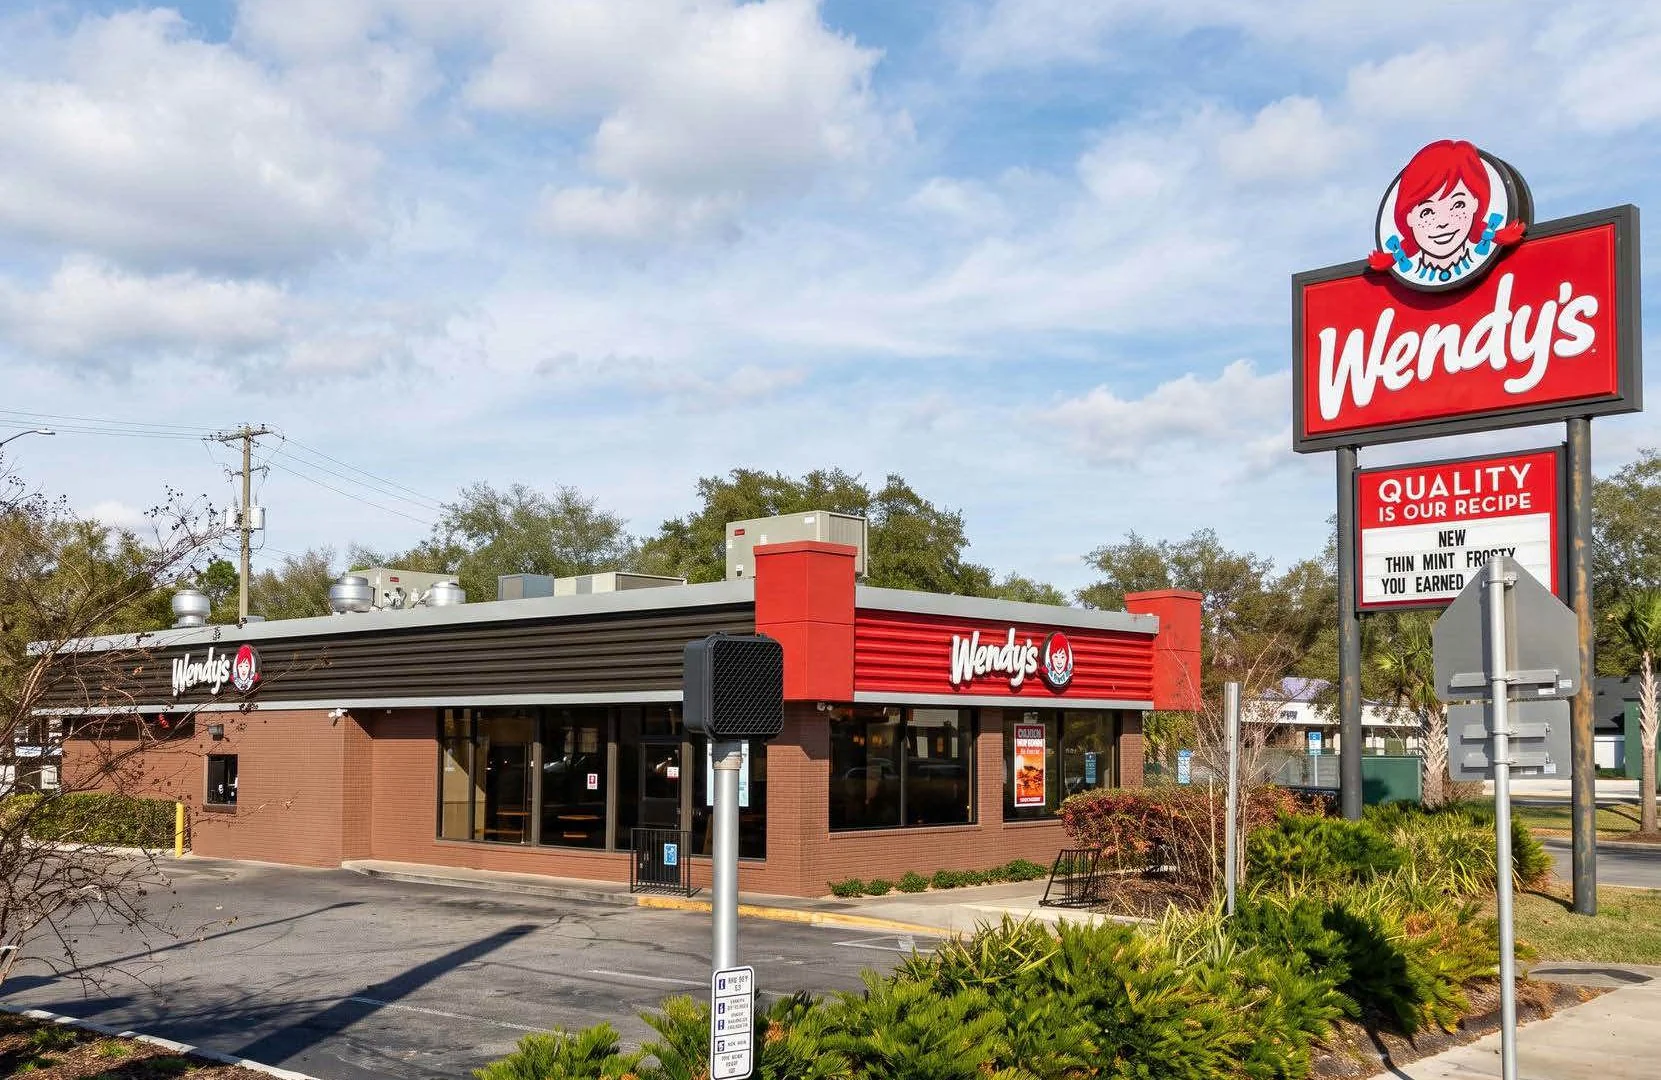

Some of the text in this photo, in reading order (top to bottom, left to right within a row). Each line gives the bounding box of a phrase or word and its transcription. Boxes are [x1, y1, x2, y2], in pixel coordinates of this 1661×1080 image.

[1318, 272, 1599, 422] Wendy's
[1378, 462, 1532, 504] QUALITY
[1378, 492, 1532, 523] IS OUR RECIPE
[1438, 529, 1466, 548] NEW
[1385, 555, 1414, 573] THIN
[1423, 552, 1455, 571] MINT
[1381, 574, 1464, 595] YOU EARNED
[172, 646, 231, 697] Wendy's
[952, 627, 1039, 687] Wendy's
